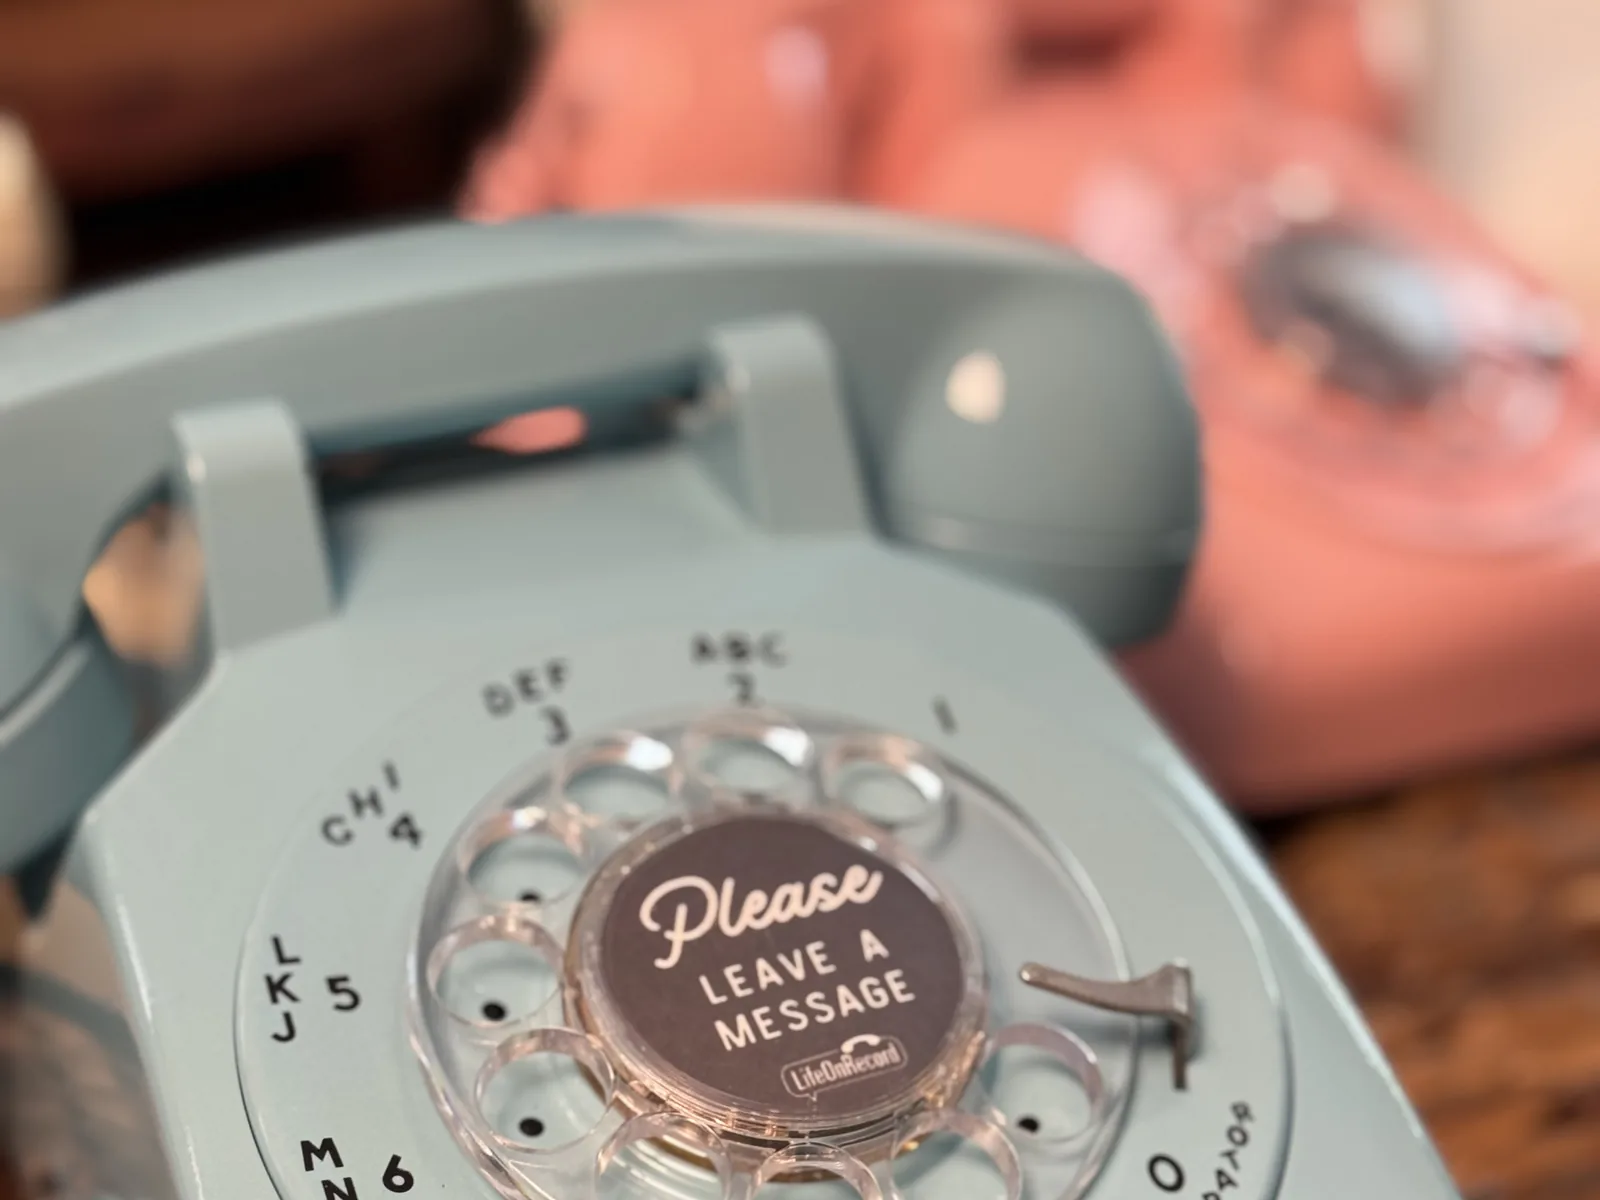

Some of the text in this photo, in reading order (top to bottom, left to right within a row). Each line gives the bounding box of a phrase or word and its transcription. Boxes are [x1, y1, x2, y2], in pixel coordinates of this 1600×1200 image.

[690, 633, 789, 667] ABC
[540, 704, 572, 746] 3
[389, 812, 423, 850] 4
[639, 864, 884, 970] Please
[699, 929, 890, 1005] LEAVE A
[325, 975, 362, 1012] 5
[713, 968, 916, 1051] MESSAGE
[790, 1043, 902, 1092] LifeOnRecord
[382, 1154, 415, 1193] 6
